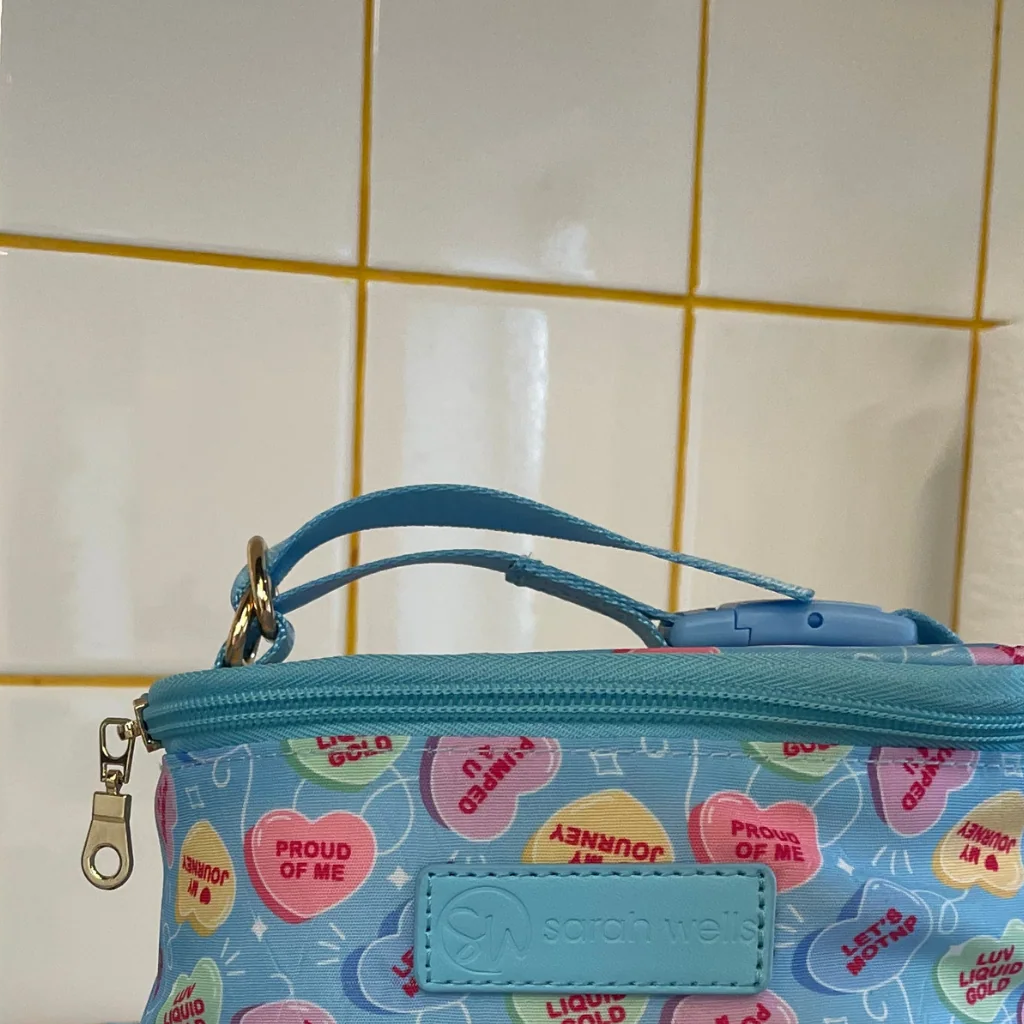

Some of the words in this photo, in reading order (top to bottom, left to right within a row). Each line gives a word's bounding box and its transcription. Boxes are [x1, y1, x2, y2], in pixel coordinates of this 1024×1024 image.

[549, 823, 664, 863] JOURNEY
[731, 820, 800, 845] PROUD
[957, 821, 1017, 854] JOURNEY
[276, 840, 351, 860] PROUD
[736, 842, 765, 859] OF
[776, 844, 804, 862] ME
[959, 844, 981, 865] MY
[182, 855, 230, 886] JOURNEY
[280, 863, 308, 879] OF
[314, 864, 345, 882] ME
[543, 910, 653, 944] sarah
[664, 911, 757, 945] wells
[976, 944, 1015, 966] LUV
[959, 961, 1024, 988] LIQUID
[965, 977, 1011, 1006] GOLD
